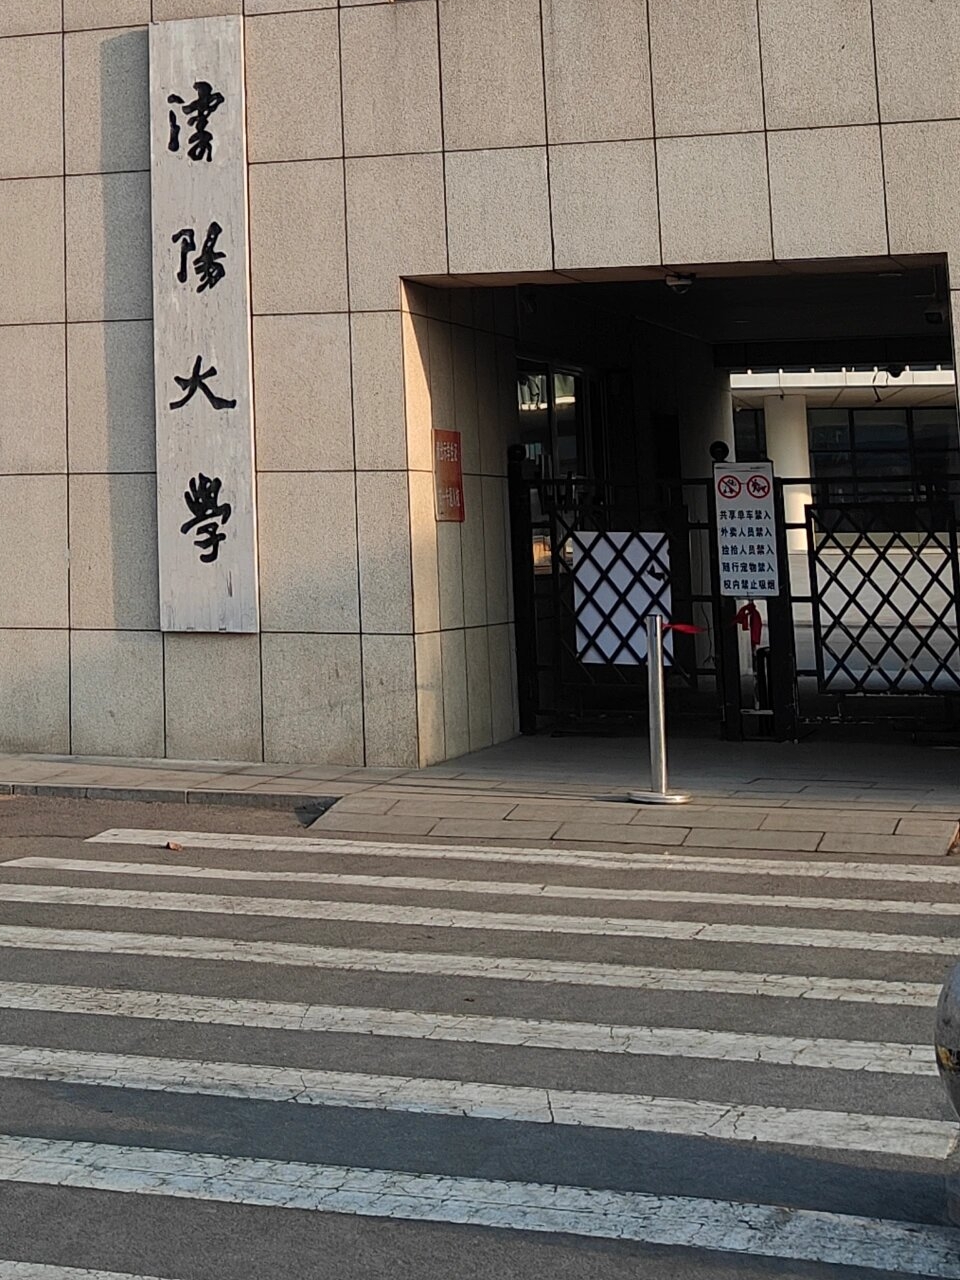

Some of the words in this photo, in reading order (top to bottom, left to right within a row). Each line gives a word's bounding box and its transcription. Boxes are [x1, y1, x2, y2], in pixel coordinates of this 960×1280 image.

[719, 509, 771, 520] 共享单车禁入
[720, 526, 772, 537] 外卖人员禁入
[722, 561, 774, 572] 随行宠物禁入
